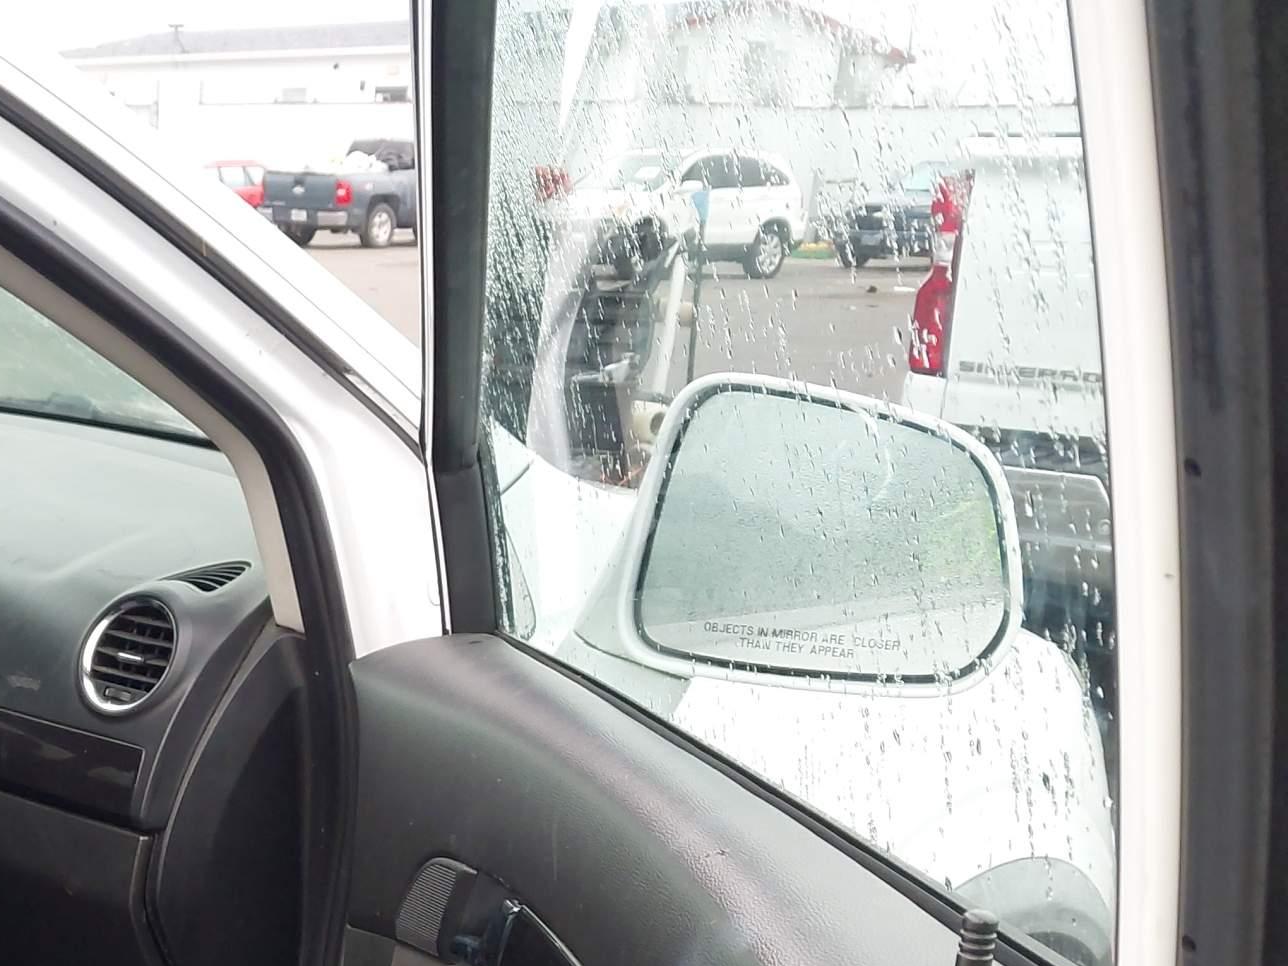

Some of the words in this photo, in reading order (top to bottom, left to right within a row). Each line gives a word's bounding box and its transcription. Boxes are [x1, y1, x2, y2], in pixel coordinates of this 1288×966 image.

[704, 621, 754, 636] OBJECTS
[757, 626, 768, 638] IN
[772, 628, 817, 642] MIRROR
[822, 633, 846, 645] ARE
[854, 636, 901, 651] CLOSER
[739, 637, 770, 650] THAN
[776, 641, 804, 653] THEY
[810, 644, 854, 658] APPEAR
